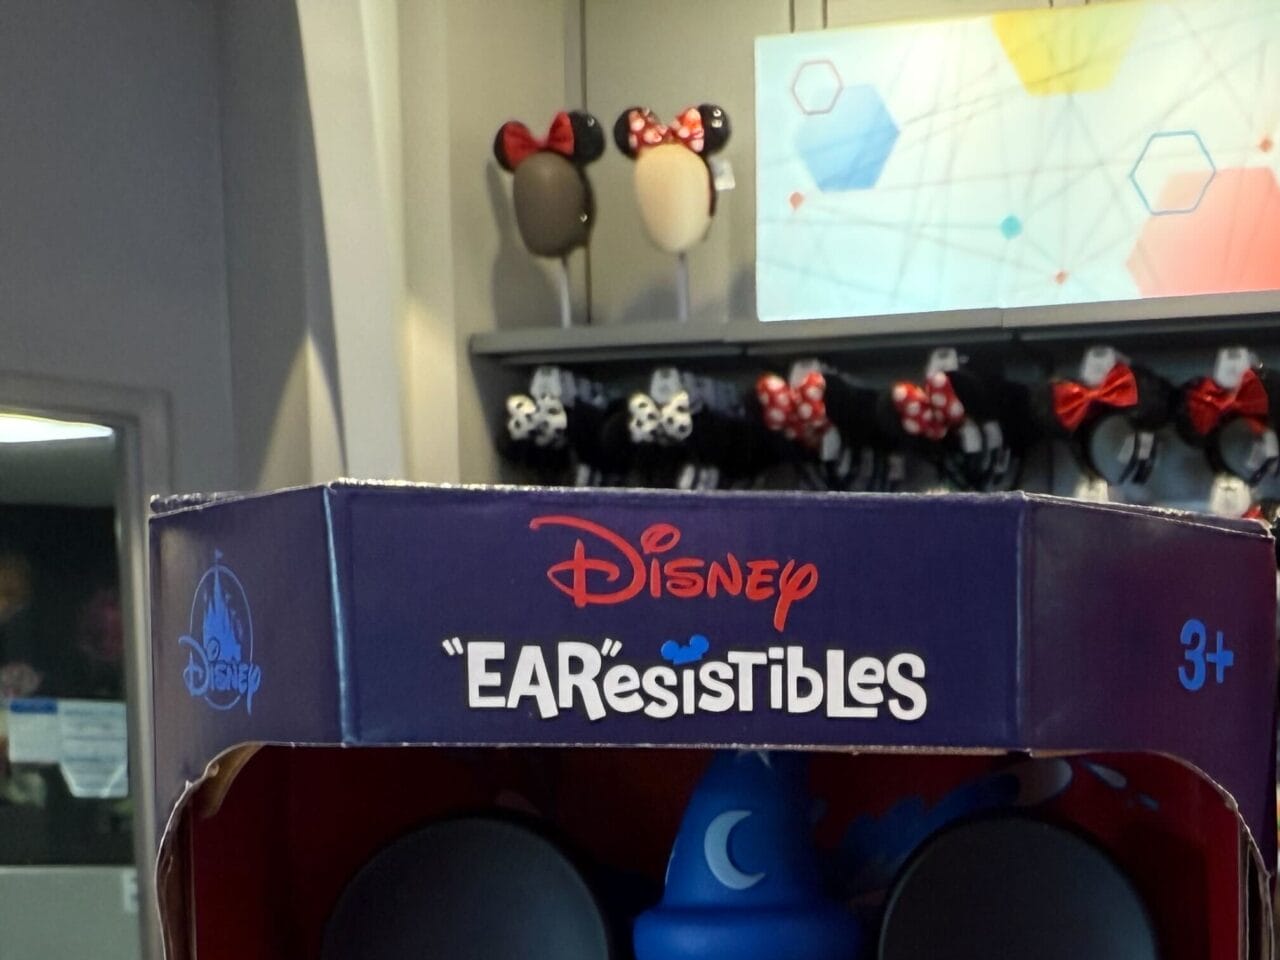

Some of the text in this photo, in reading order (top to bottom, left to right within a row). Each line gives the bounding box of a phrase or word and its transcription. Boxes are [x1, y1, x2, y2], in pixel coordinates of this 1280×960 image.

[529, 514, 819, 632] Disney
[178, 635, 262, 716] Disney
[1177, 618, 1235, 692] 3+
